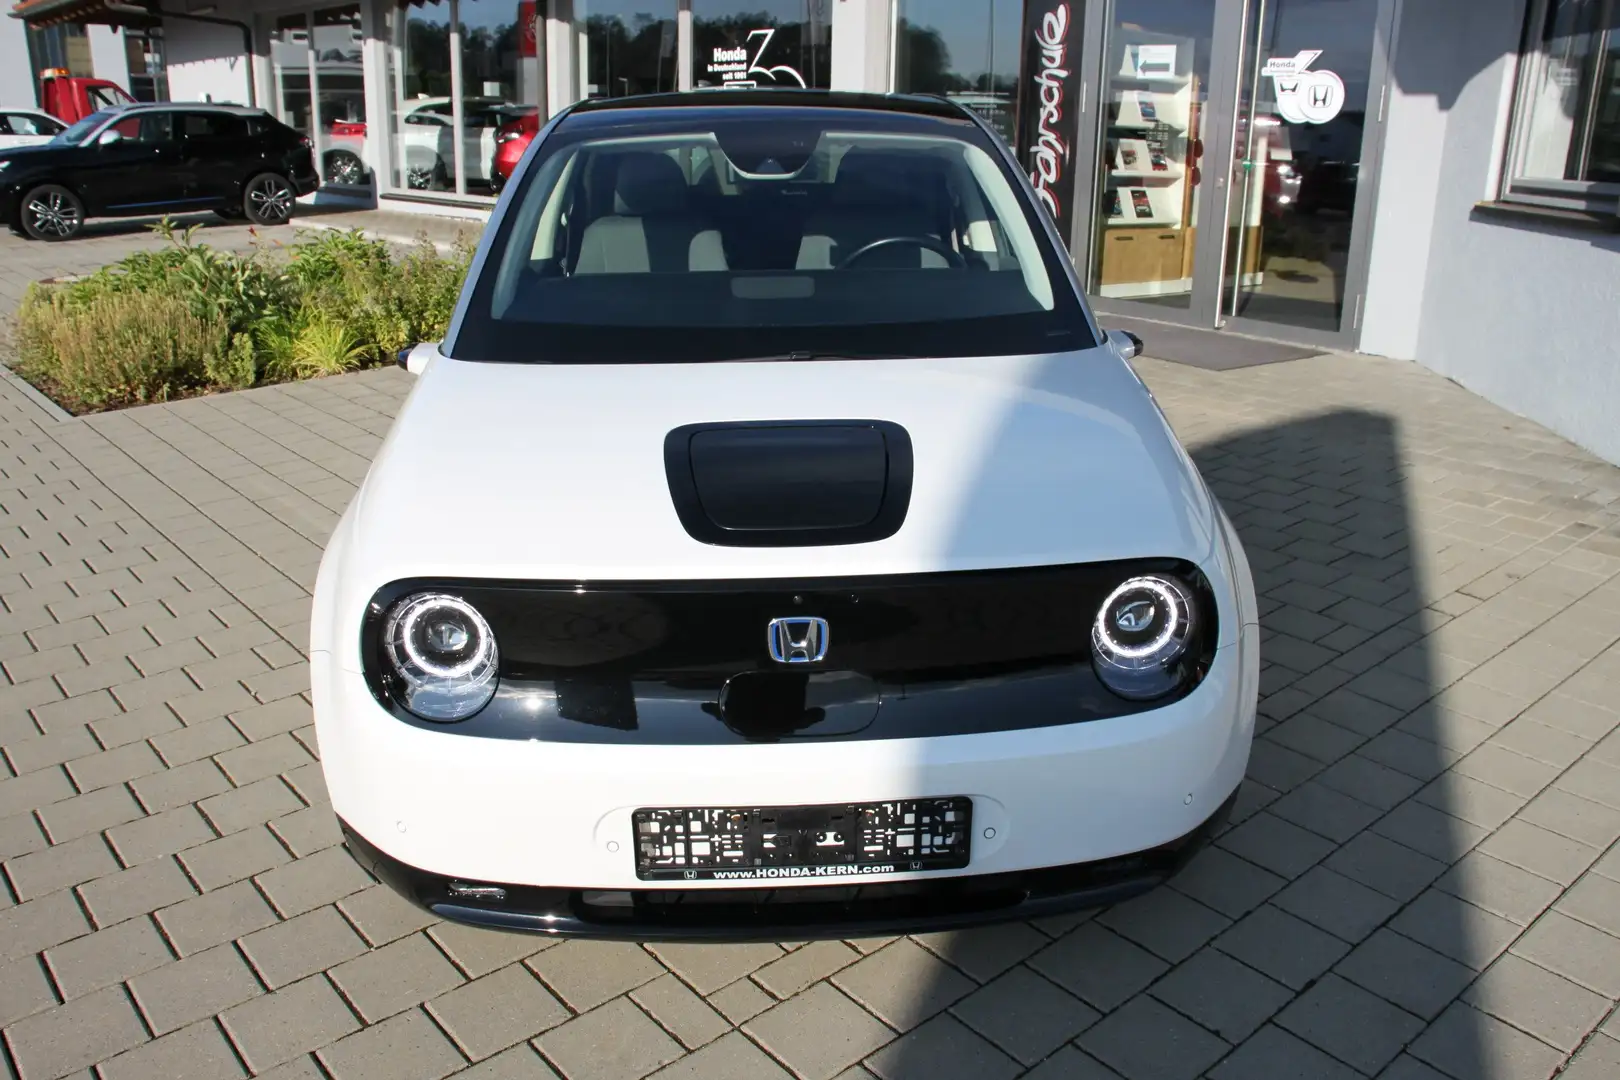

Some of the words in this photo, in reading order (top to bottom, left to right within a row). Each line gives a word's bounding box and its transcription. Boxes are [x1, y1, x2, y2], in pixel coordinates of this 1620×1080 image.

[713, 46, 747, 62] Honda
[1269, 60, 1296, 69] Honda
[713, 863, 895, 879] www.HONDA-KERN.com
